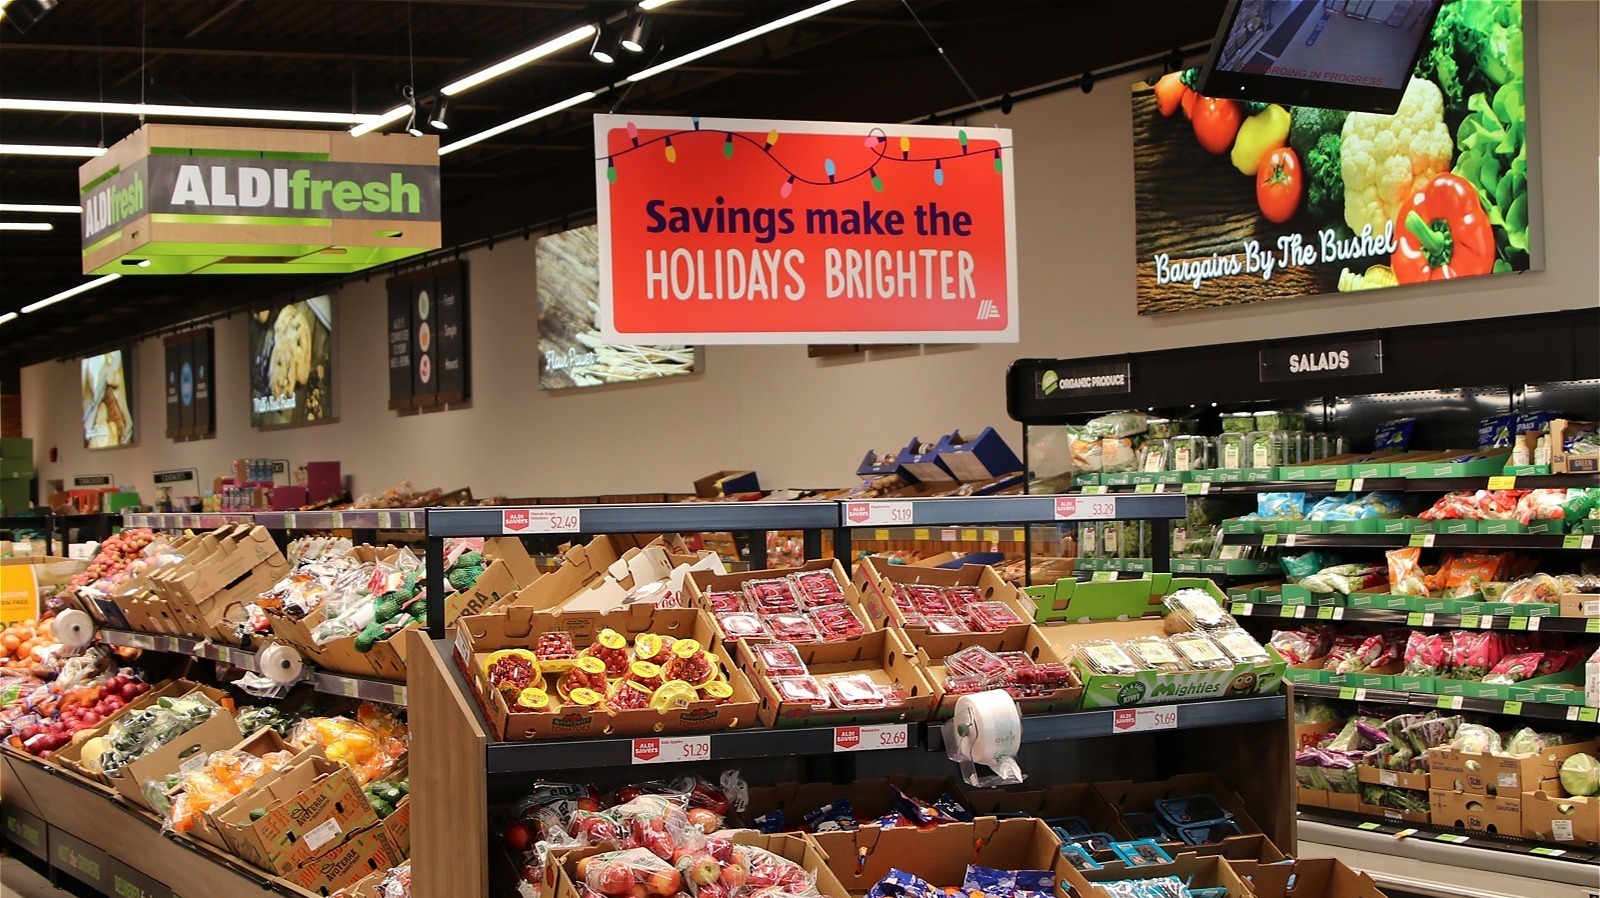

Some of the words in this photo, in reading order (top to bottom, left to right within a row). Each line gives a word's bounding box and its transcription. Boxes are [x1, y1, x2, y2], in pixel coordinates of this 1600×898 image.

[1309, 70, 1321, 80] IN
[1324, 71, 1384, 86] PROGRESS
[170, 164, 421, 213] ALDIfresh
[85, 170, 144, 238] ALDIfresh
[645, 196, 795, 243] Savings
[806, 201, 905, 236] make
[914, 202, 973, 237] the
[1155, 253, 1243, 290] Bargains
[1244, 240, 1278, 281] By
[1277, 233, 1318, 270] The
[1318, 220, 1398, 262] Bushel
[645, 247, 806, 301] HOLIDAYS
[825, 247, 977, 300] BRIGHTER
[1288, 350, 1350, 373] SALADS
[1059, 377, 1091, 389] ORGANIC
[1092, 374, 1125, 387] PRODUCE
[1574, 459, 1593, 467] GREEN
[891, 508, 912, 521] $1.19
[1092, 503, 1114, 515] $3.29
[550, 515, 578, 530] $2.49
[1150, 682, 1221, 697] Mighties
[1122, 693, 1140, 705] KIWI
[679, 719, 718, 728] TOMATOES
[1154, 712, 1176, 726] $1.69
[551, 724, 591, 733] TOMATOES
[880, 731, 906, 745] $2.69
[683, 743, 709, 758] $1.29
[326, 849, 358, 882] AVOTERRA
